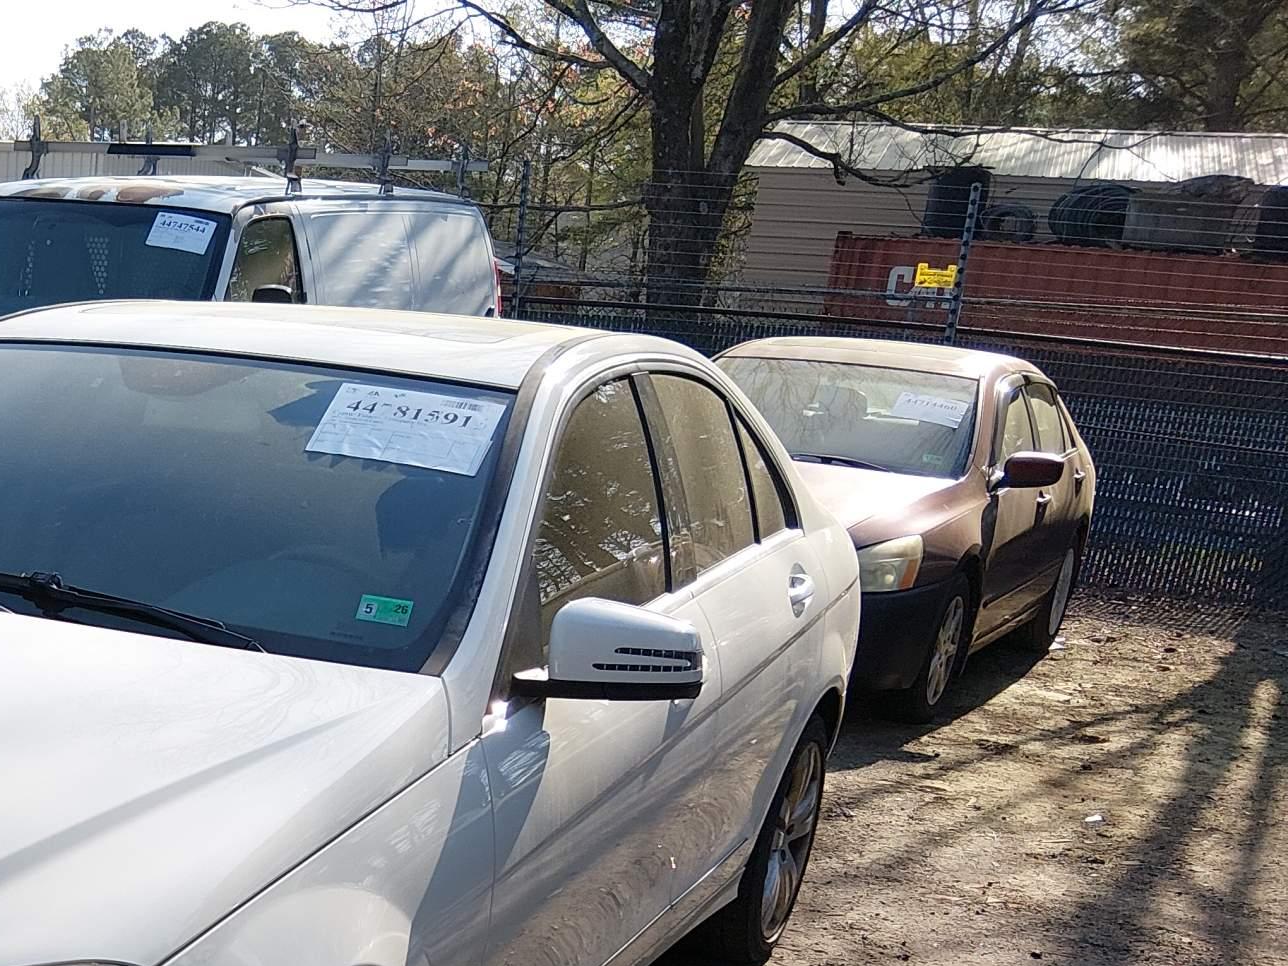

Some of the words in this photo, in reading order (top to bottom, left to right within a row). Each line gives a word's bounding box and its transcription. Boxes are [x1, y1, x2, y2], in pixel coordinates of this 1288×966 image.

[160, 219, 207, 234] 44747544
[364, 603, 374, 615] 5
[394, 603, 409, 615] 26
